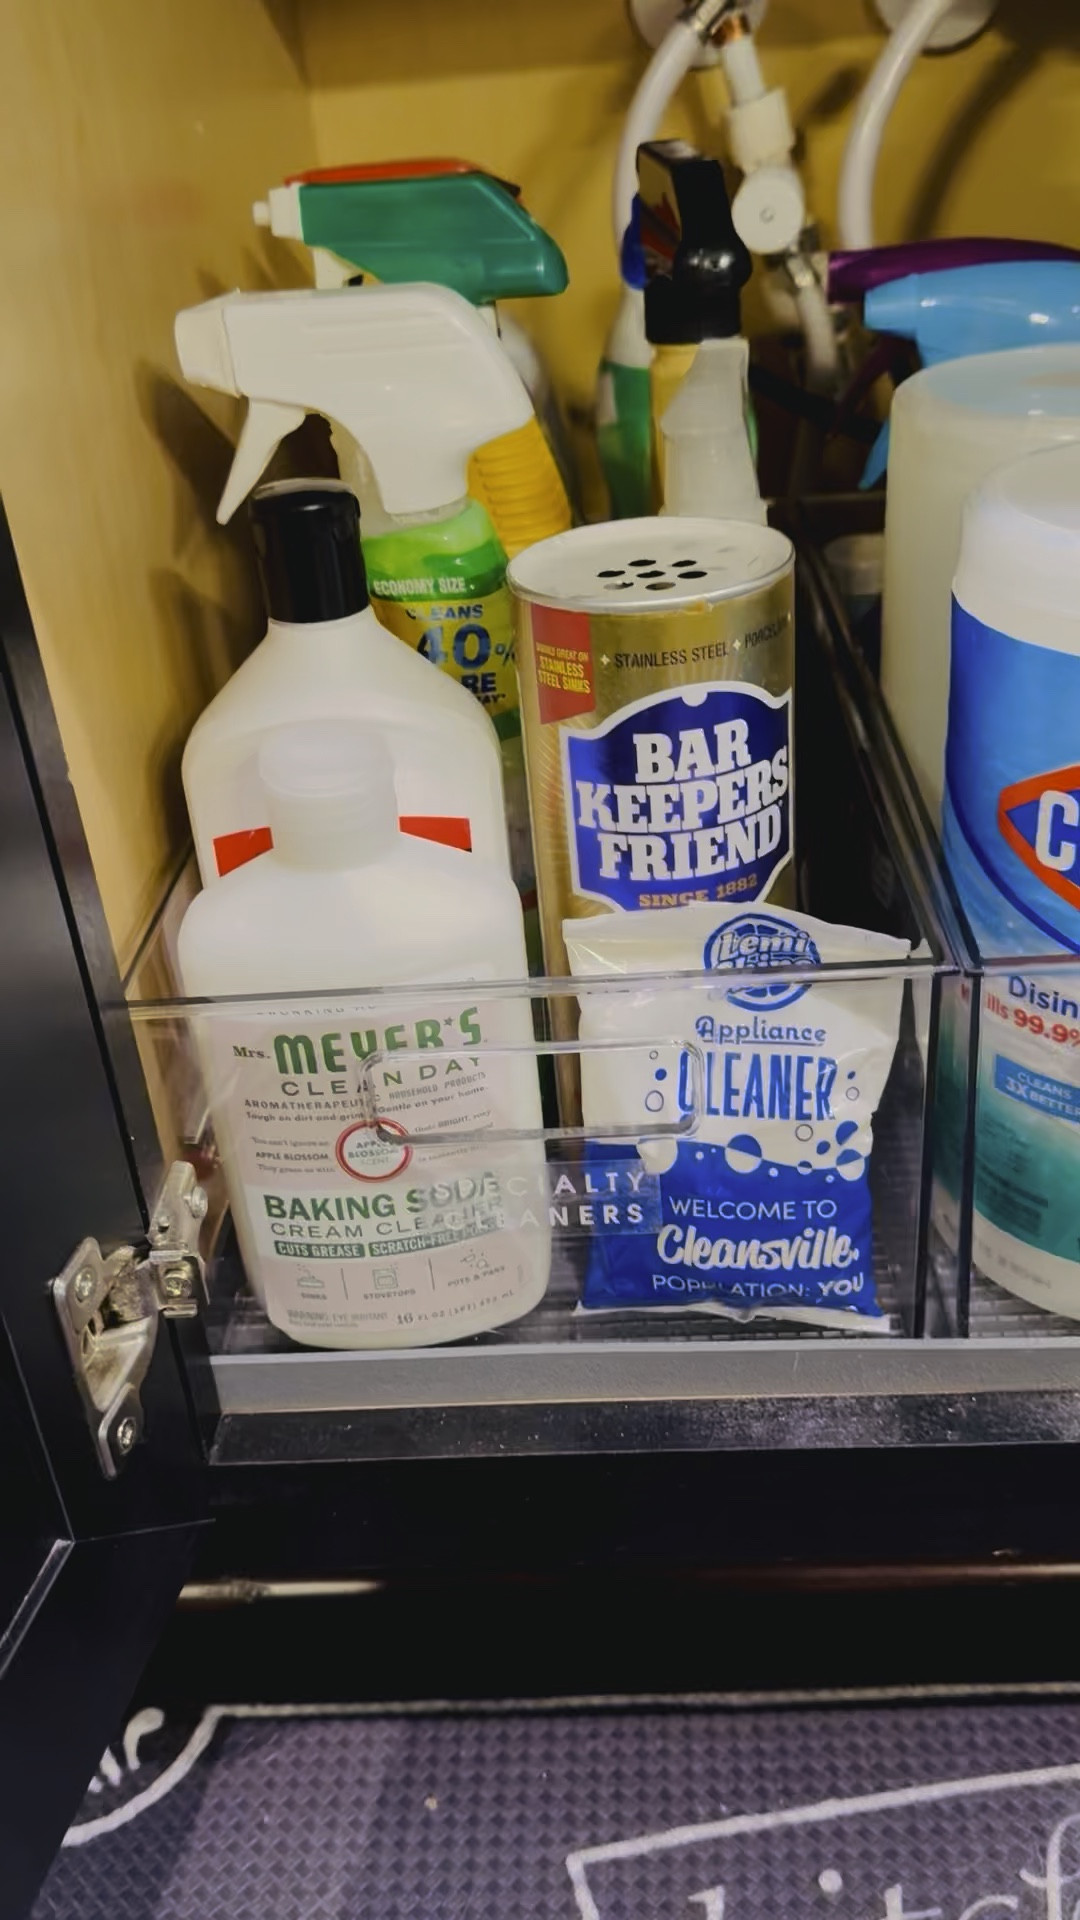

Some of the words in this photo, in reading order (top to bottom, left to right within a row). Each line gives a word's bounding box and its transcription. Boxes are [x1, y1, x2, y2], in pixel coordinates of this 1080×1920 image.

[373, 578, 435, 596] ECONOMY
[439, 577, 467, 593] SIZE
[405, 604, 483, 621] CEANS
[539, 656, 584, 678] STAINLESS
[614, 650, 687, 669] STAINLESS
[691, 642, 729, 663] STEEL
[461, 673, 496, 694] RE
[538, 669, 561, 689] STEEL
[562, 676, 591, 694] SINKS
[633, 718, 752, 784] BAR
[576, 745, 789, 834] KEEPERS
[597, 803, 782, 881] FRIEND
[639, 888, 709, 908] SINCE
[716, 873, 758, 900] 1882
[718, 930, 810, 962] Lemi
[695, 1015, 826, 1045] Appliance
[232, 1045, 271, 1060] Mrs.
[281, 1070, 403, 1097] CLEAN
[419, 1057, 481, 1081] DAY
[677, 1050, 837, 1121] CLEANER
[1006, 1076, 1028, 1098] 3X
[1018, 1071, 1072, 1100] CLEANS
[244, 1094, 381, 1110] AROMATHERAPEUTC
[444, 1071, 486, 1089] PRODUCTS
[294, 1112, 313, 1121] dirt
[316, 1112, 337, 1121] and
[414, 1100, 428, 1108] on
[431, 1095, 455, 1106] your
[284, 1152, 329, 1161] BLOSSOM
[263, 1193, 397, 1222] BAKING
[406, 1171, 501, 1213] SODA
[433, 1171, 645, 1198] SPECIALTY
[444, 1204, 644, 1231] CLEANERS
[669, 1194, 796, 1220] WELCOME
[802, 1199, 838, 1219] TO
[270, 1222, 363, 1239] CREAM
[277, 1242, 310, 1257] CUTS
[312, 1243, 361, 1258] GREASE
[363, 1288, 417, 1301] STOVETOPS
[816, 1272, 865, 1298] YOU
[396, 1312, 414, 1325] 16
